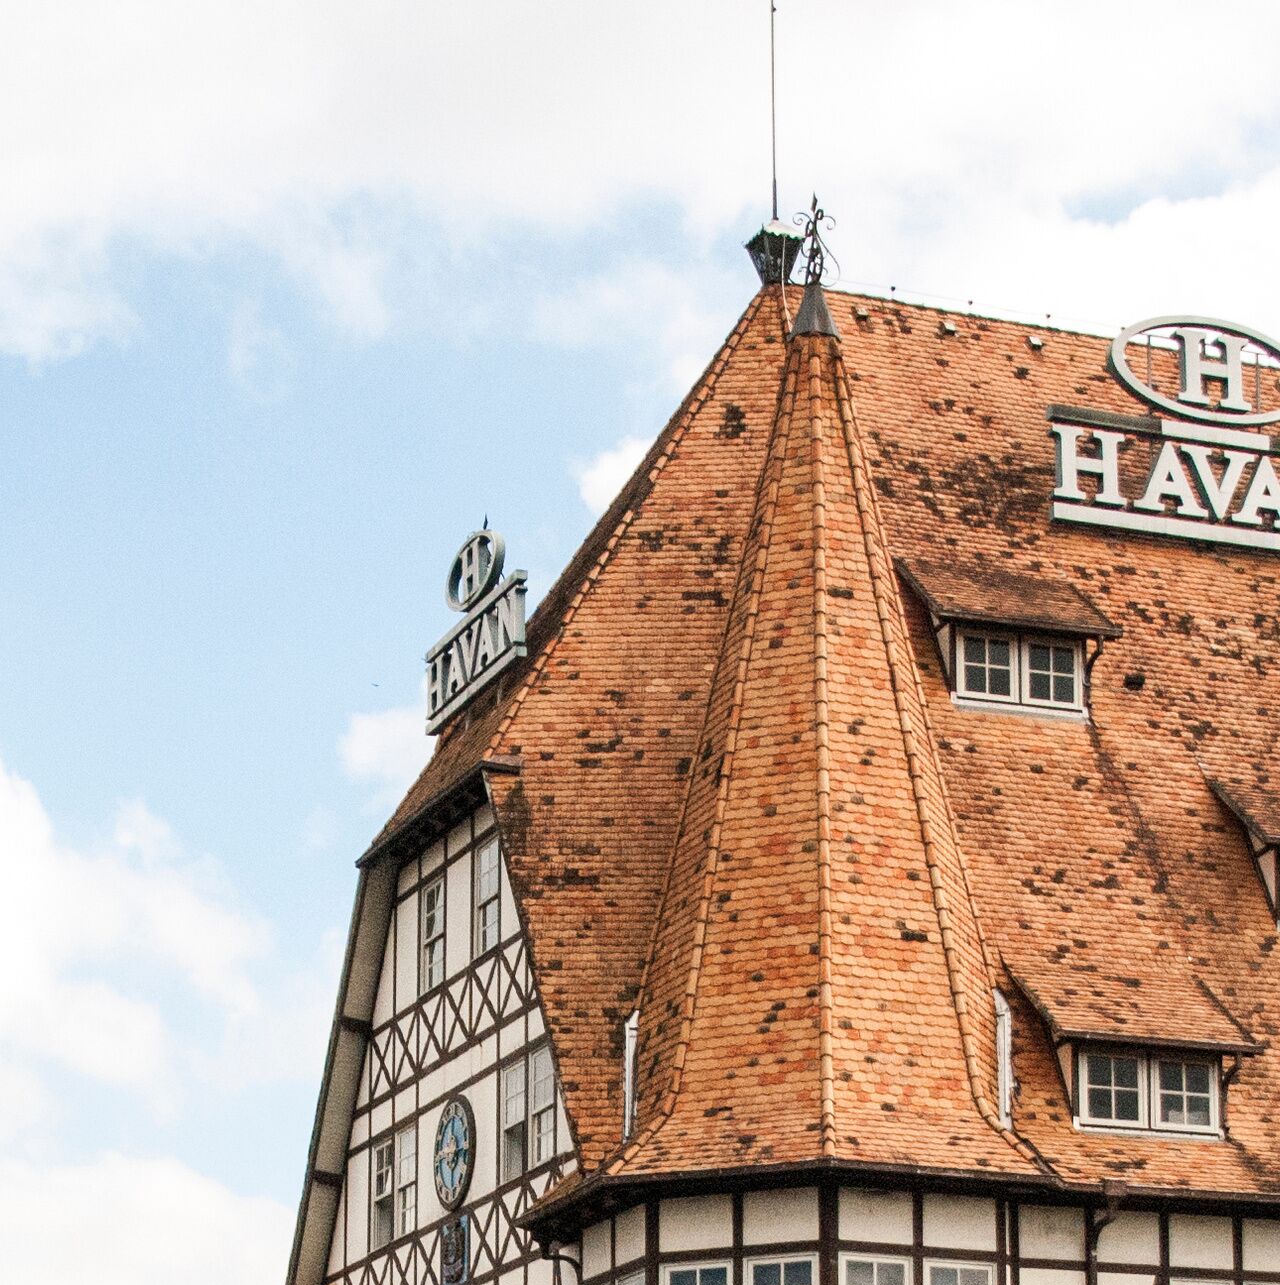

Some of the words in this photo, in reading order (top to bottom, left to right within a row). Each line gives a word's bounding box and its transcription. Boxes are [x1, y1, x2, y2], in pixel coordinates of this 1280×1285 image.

[1171, 328, 1253, 413] H
[460, 537, 484, 599] H
[426, 584, 528, 720] HAVAN
